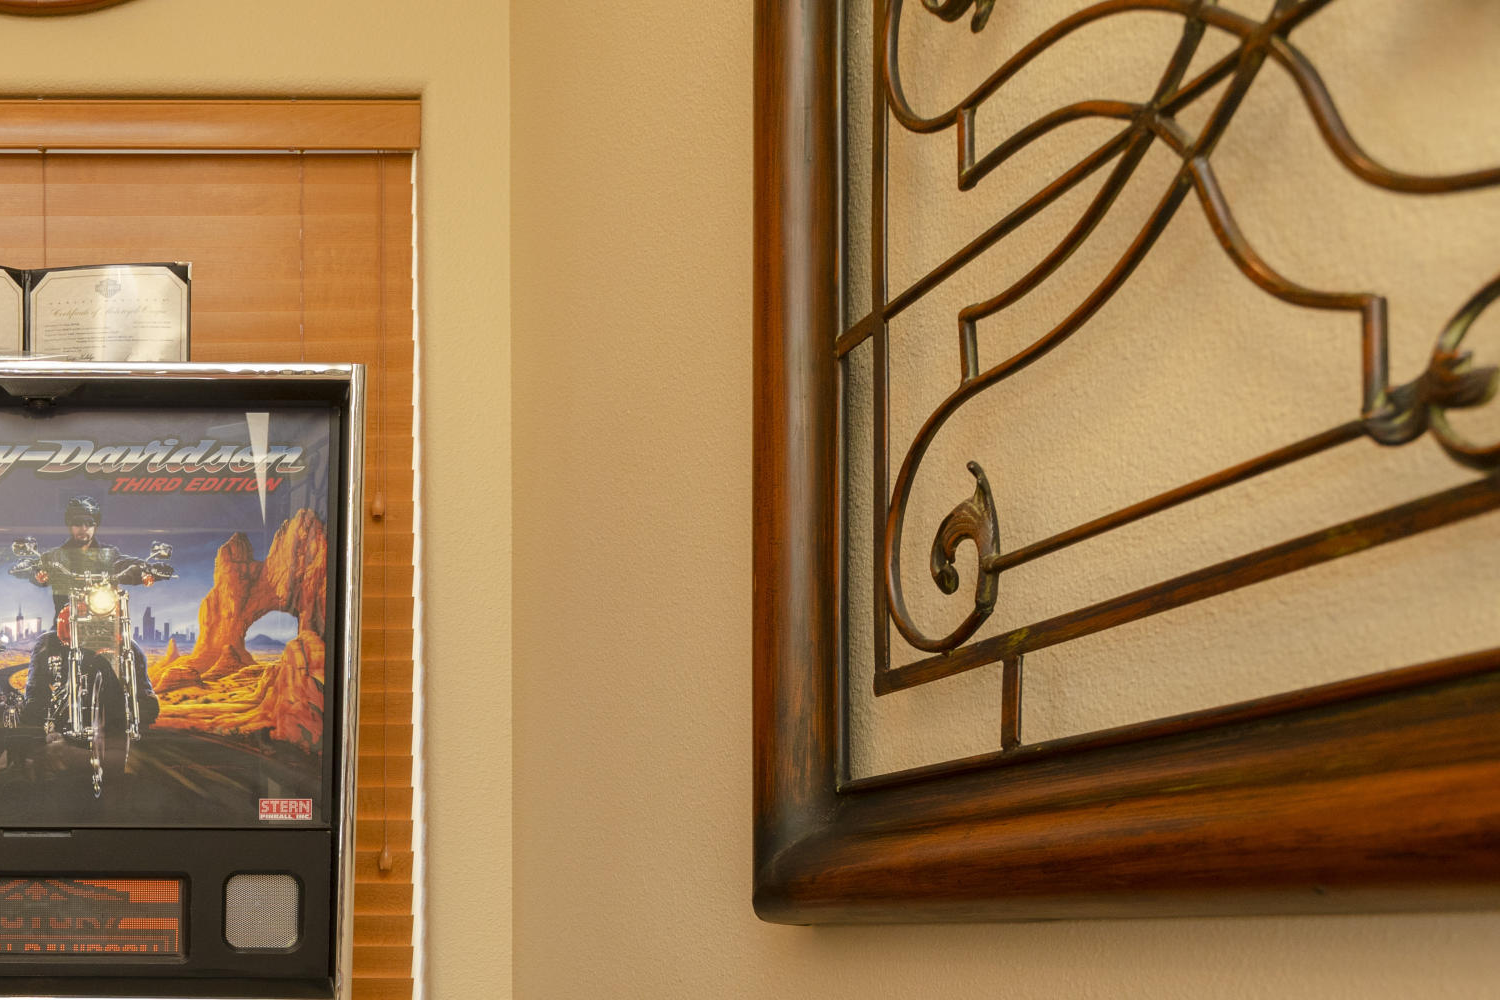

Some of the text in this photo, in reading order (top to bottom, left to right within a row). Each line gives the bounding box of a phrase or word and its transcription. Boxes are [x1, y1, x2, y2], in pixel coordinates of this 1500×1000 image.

[112, 477, 283, 492] THIRD EDITION
[261, 800, 310, 813] STERN
